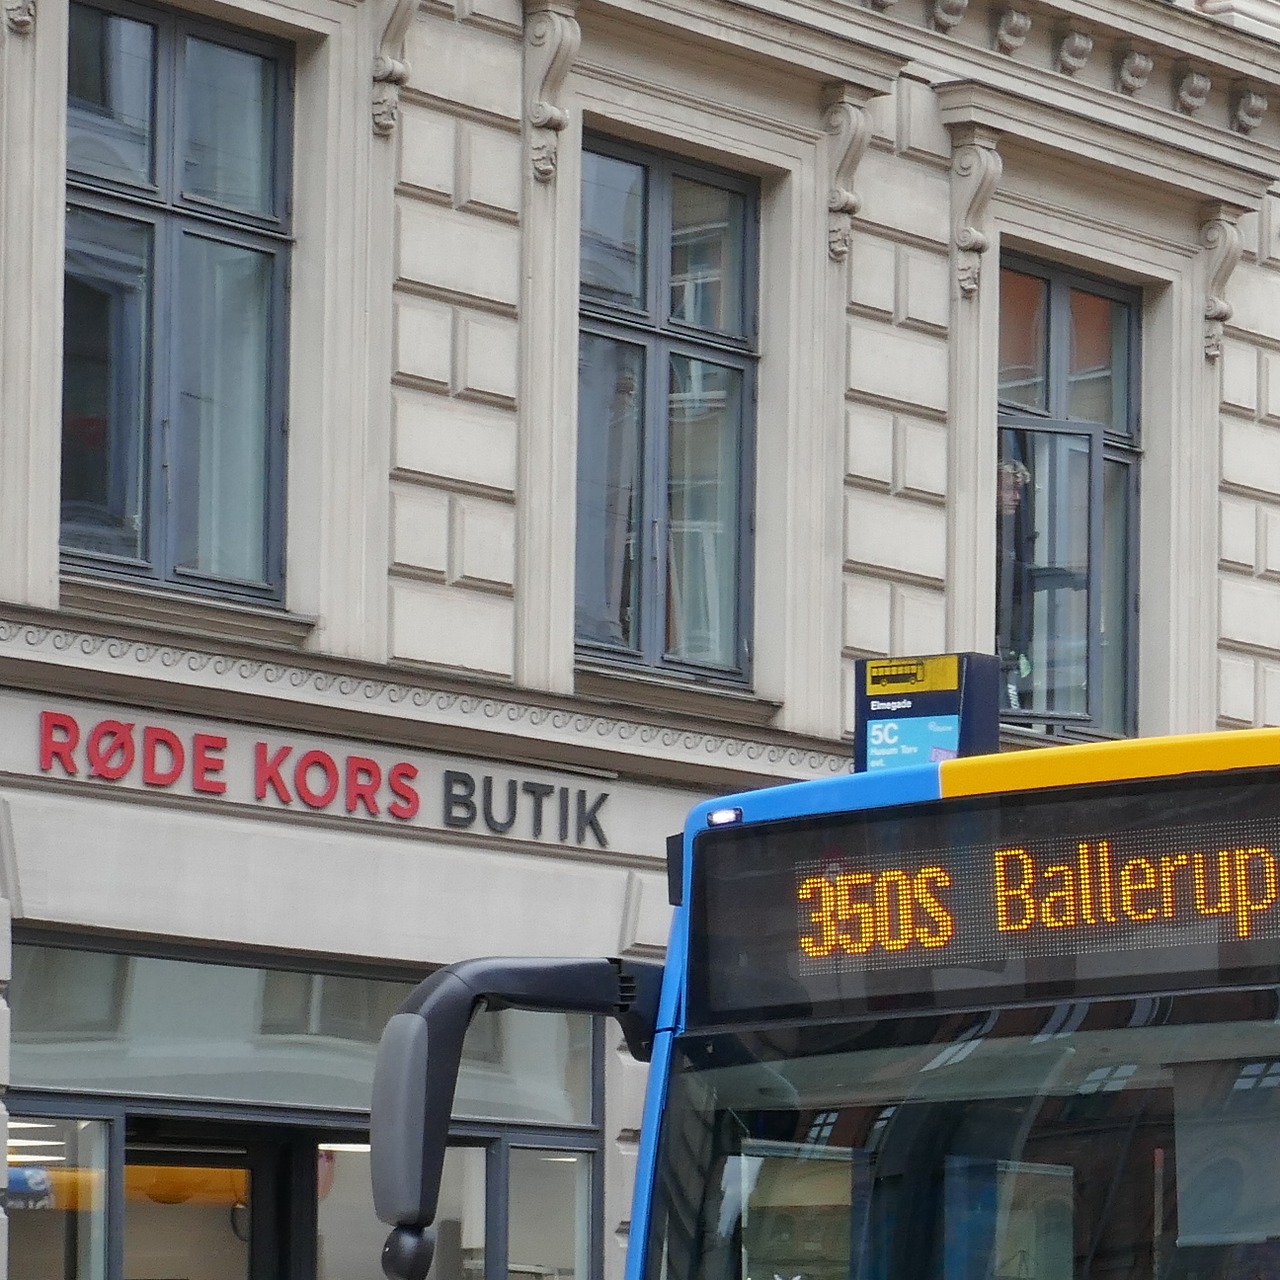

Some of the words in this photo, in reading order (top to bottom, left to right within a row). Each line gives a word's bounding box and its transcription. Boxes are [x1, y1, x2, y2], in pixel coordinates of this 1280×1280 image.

[870, 699, 912, 711] Elmegade
[871, 722, 899, 745] 5C
[40, 711, 228, 794] RØDE
[255, 742, 421, 820] KORS
[443, 770, 609, 847] BUTIK
[796, 864, 954, 958] 350S
[994, 839, 1280, 940] Ballerup
